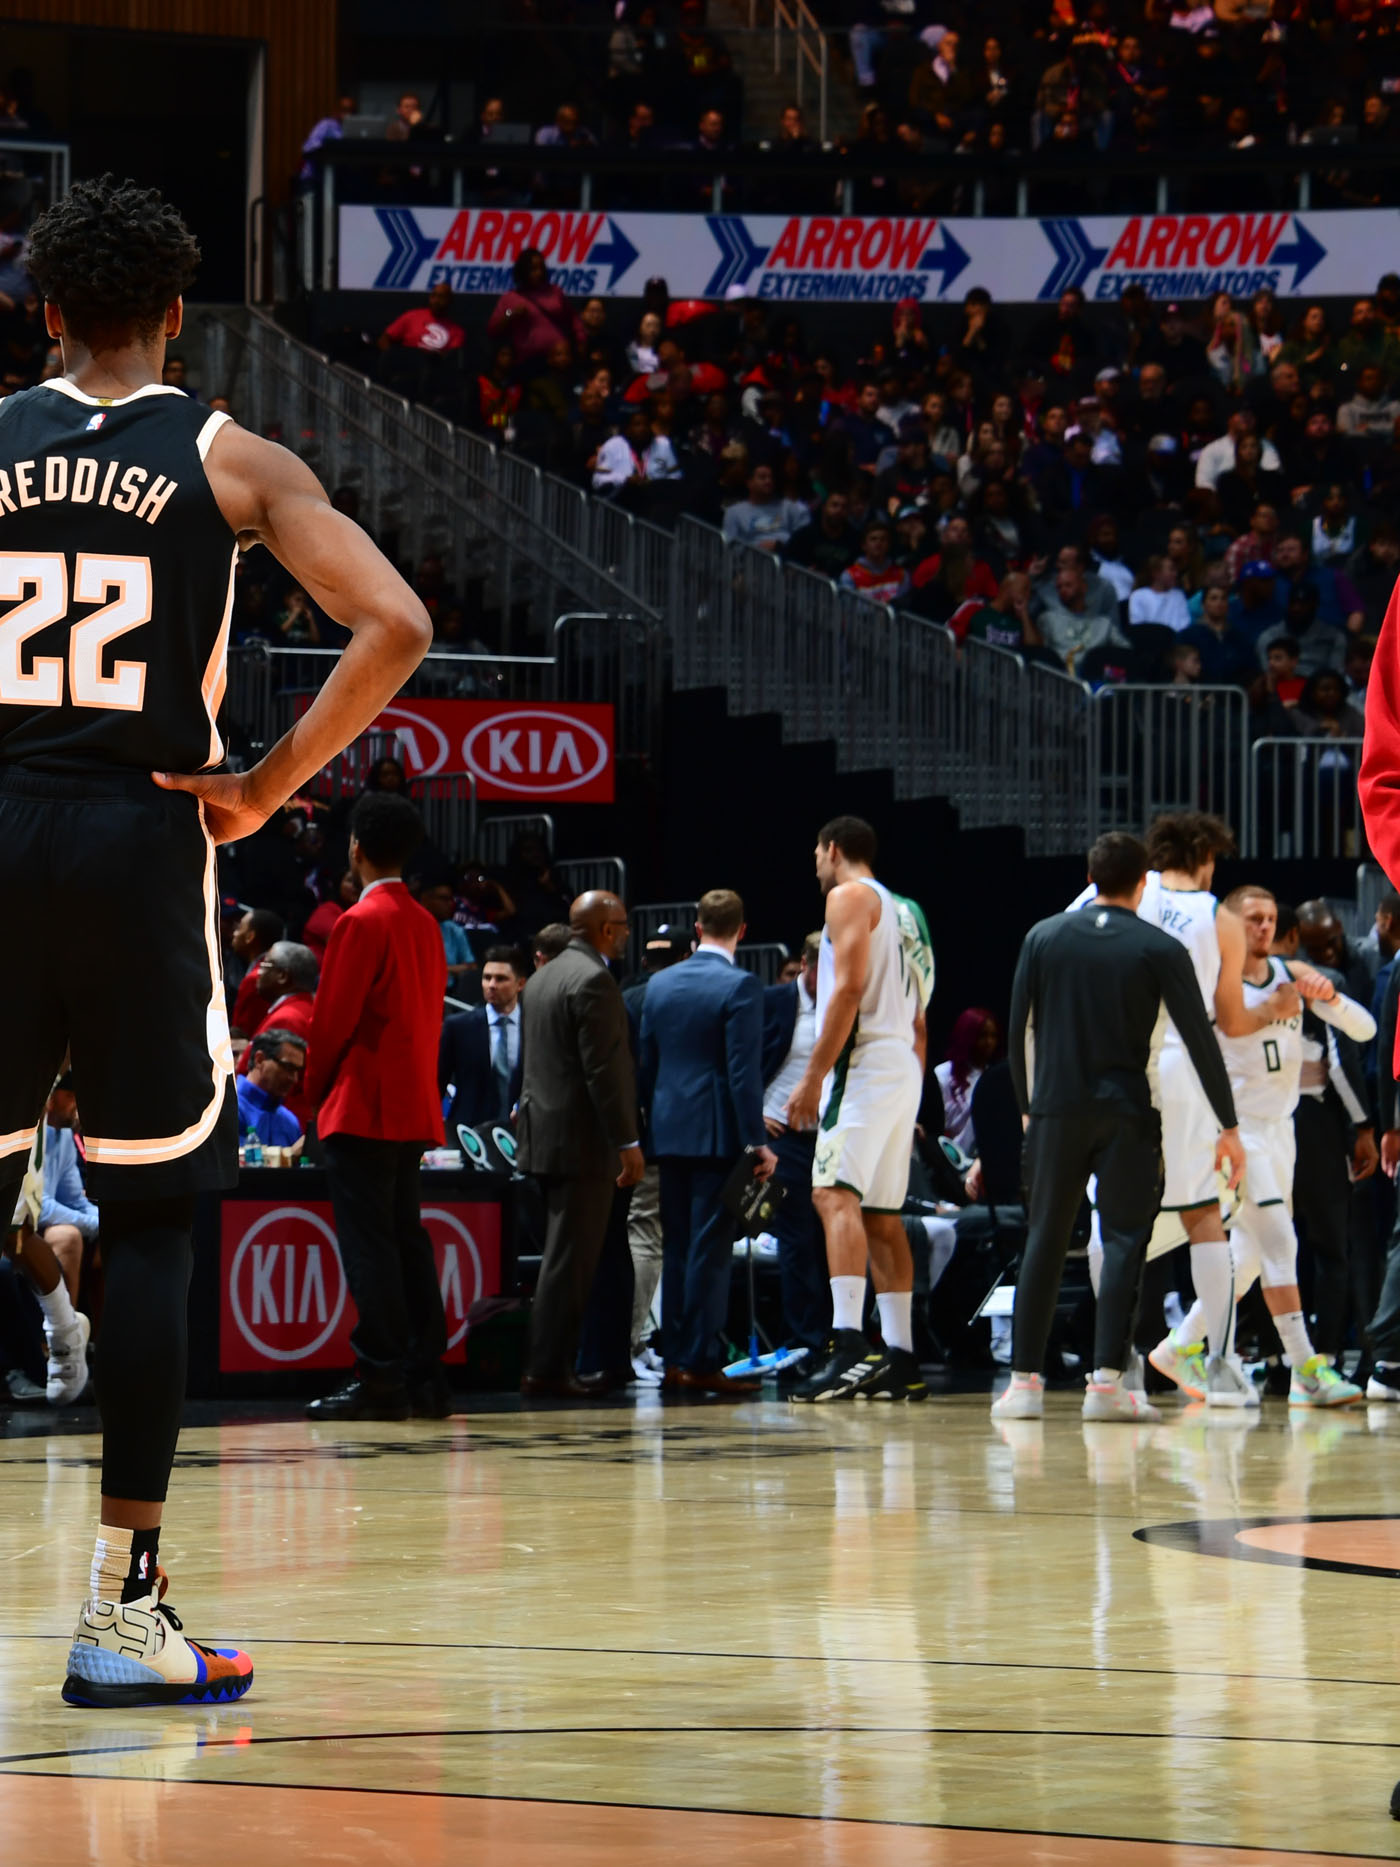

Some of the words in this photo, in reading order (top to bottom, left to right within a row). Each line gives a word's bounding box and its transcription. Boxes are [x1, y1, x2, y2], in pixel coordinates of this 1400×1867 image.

[435, 209, 606, 264] ARROW
[766, 216, 938, 271] ARROW
[1104, 213, 1291, 269] ARROW
[758, 272, 929, 299] EXTERMINATORS
[488, 729, 583, 774] KIA
[1263, 1039, 1281, 1073] 0
[252, 1244, 327, 1325] KIA
